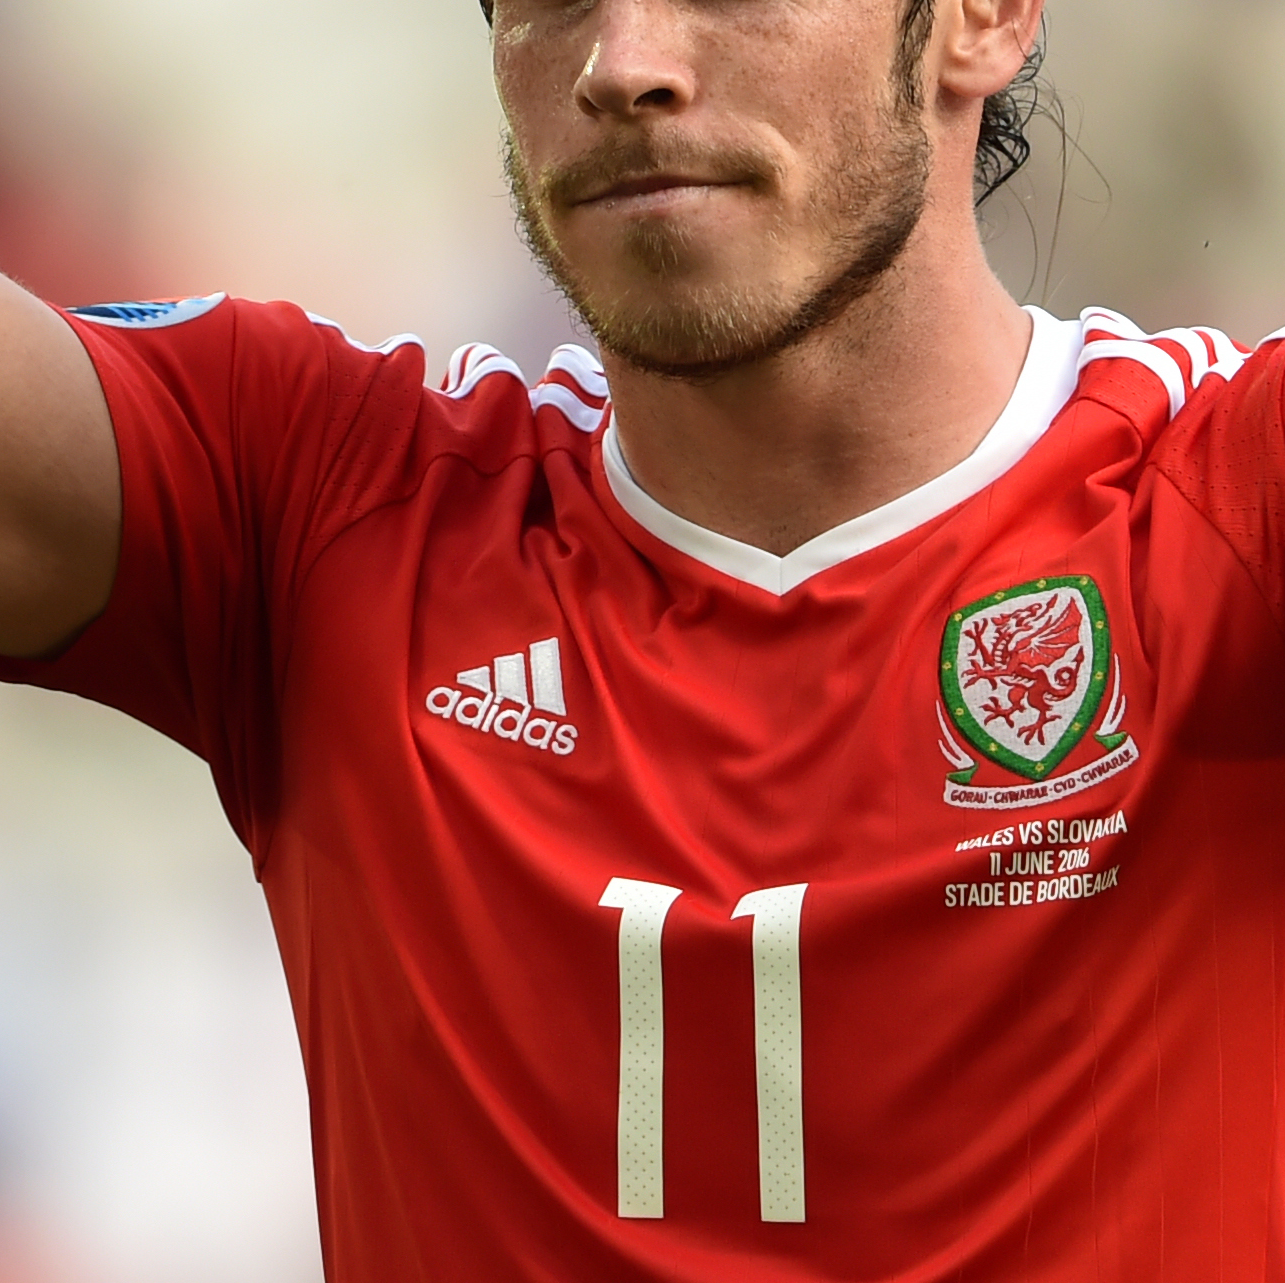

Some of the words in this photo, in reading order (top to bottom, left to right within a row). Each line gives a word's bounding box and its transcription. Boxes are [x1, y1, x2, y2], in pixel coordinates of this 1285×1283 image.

[426, 686, 579, 755] adidas
[950, 789, 988, 804] GORAU
[994, 785, 1049, 804] CHWARAE
[1053, 777, 1076, 793] CYD
[955, 826, 1014, 852] WALES
[1018, 820, 1043, 845] VS
[1047, 809, 1128, 844] SLOVAKIA
[989, 852, 1001, 876] 11
[1004, 850, 1055, 876] JUNE
[1057, 846, 1090, 873] 2016
[944, 881, 1005, 907] STADE
[1009, 881, 1034, 906] DE
[1036, 864, 1121, 903] BORDEAUX
[597, 876, 809, 1223] 11
